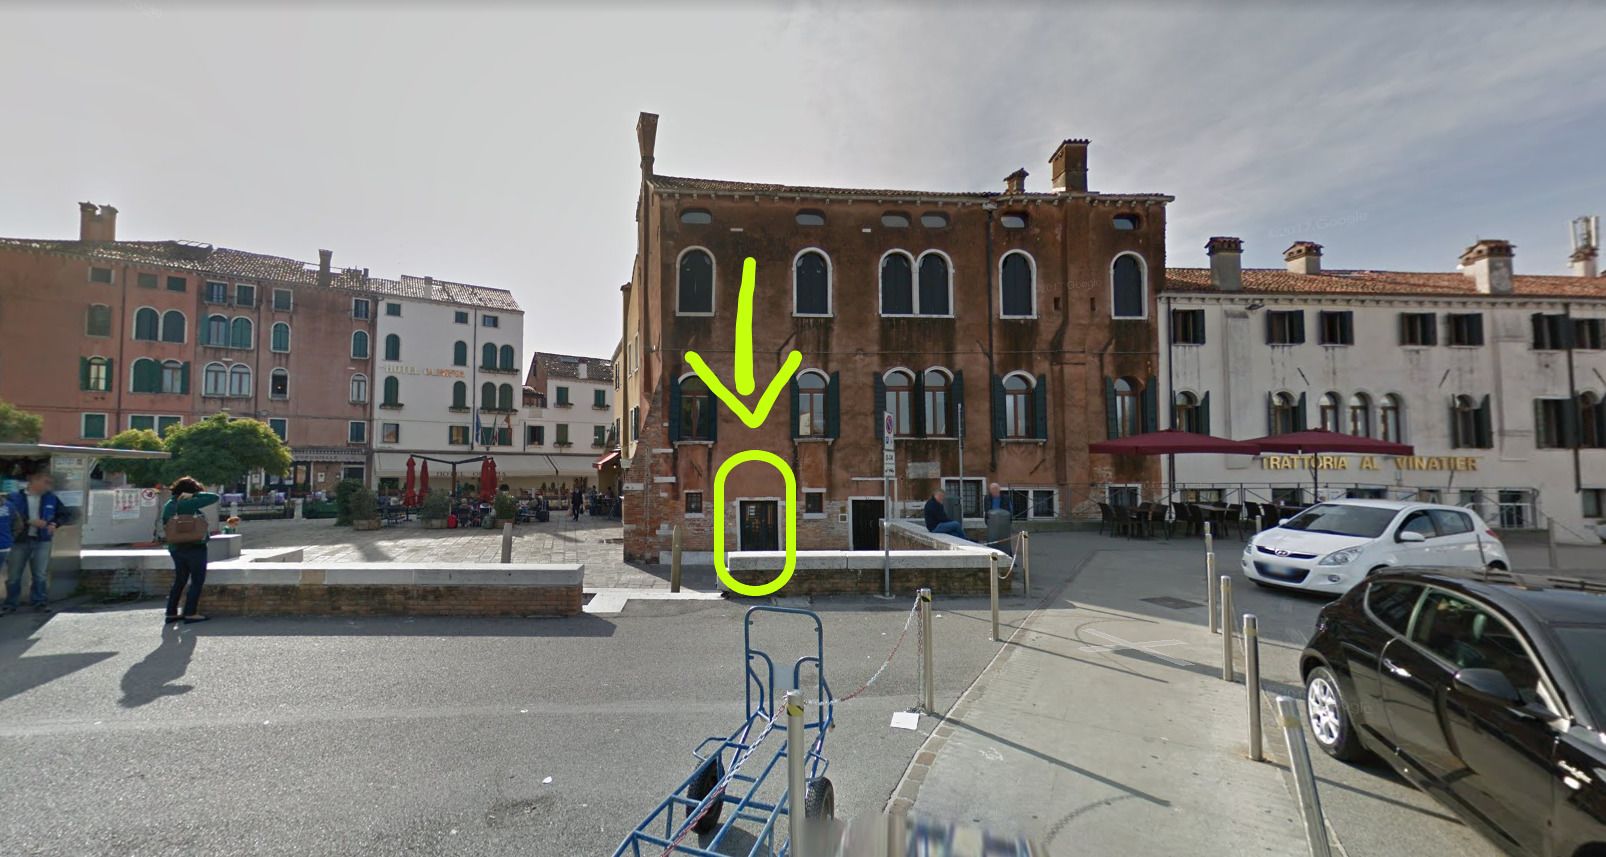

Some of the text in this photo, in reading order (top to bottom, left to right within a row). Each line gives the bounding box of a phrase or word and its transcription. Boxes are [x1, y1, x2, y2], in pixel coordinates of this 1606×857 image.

[1262, 455, 1479, 471] TRATTORIA AL VINATIER
